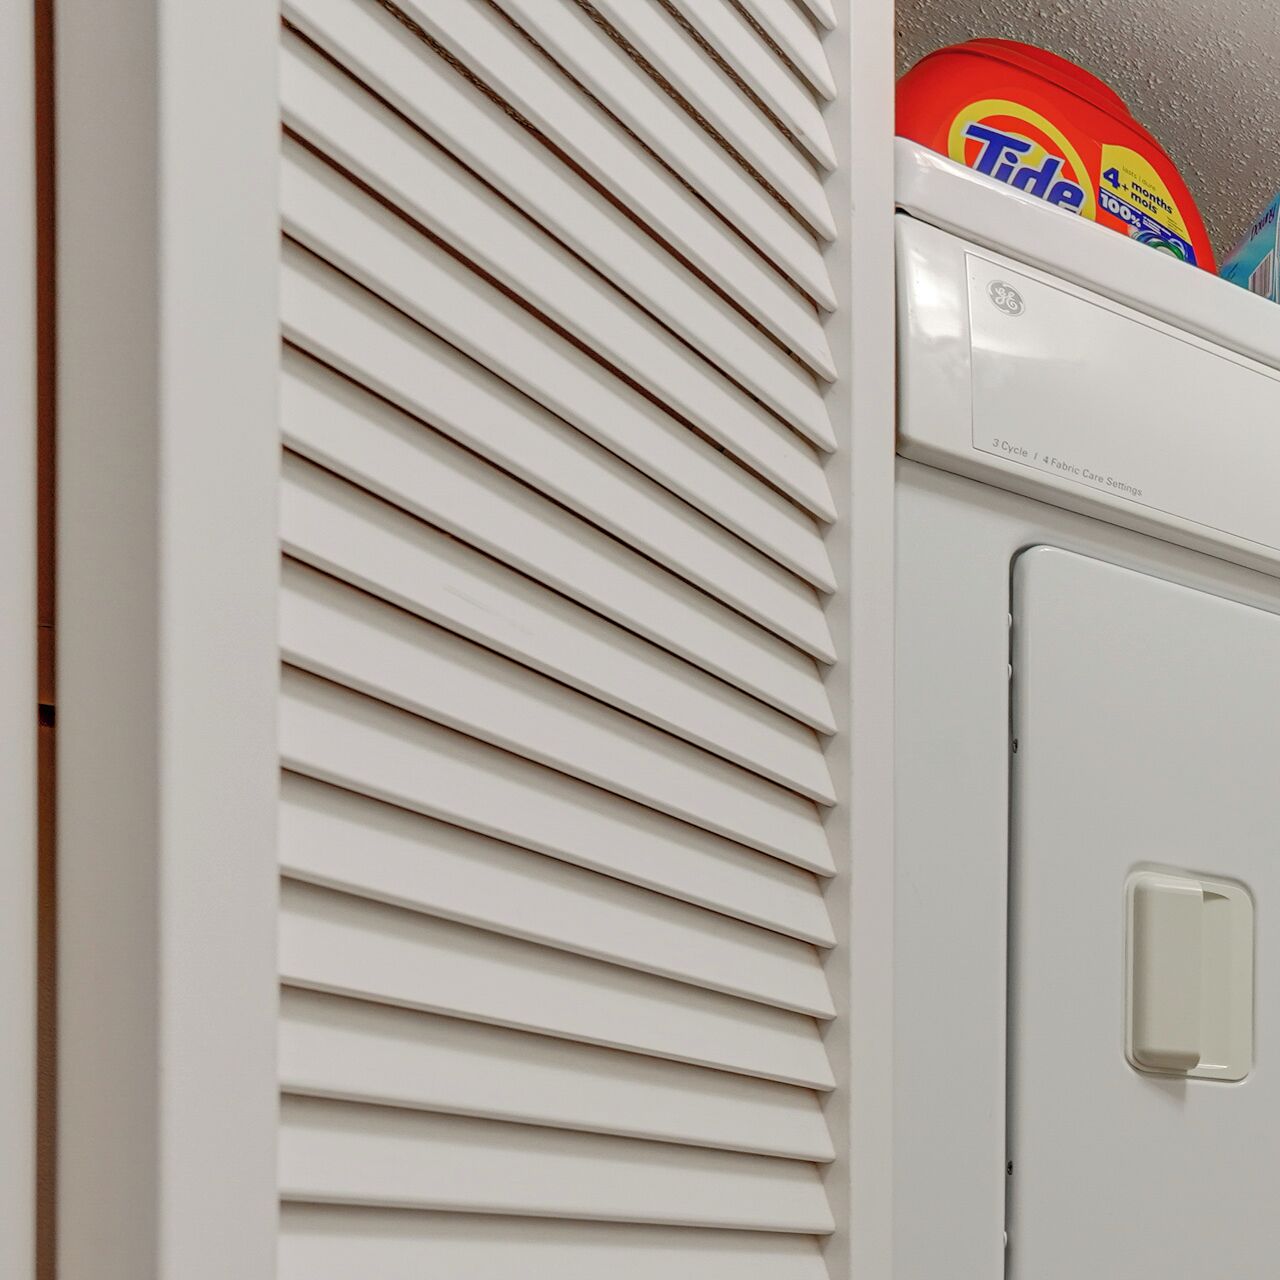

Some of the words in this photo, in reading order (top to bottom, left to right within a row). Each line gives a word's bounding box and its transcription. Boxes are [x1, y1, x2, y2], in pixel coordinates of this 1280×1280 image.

[965, 123, 1084, 215] Tide
[1100, 193, 1141, 228] 100%
[1131, 192, 1158, 214] mois
[1132, 182, 1173, 214] months
[992, 438, 1000, 448] 3
[1001, 440, 1029, 458] Cycle
[1042, 456, 1049, 464] 4
[1050, 458, 1080, 475] Fabric
[1082, 468, 1104, 483] Care
[1105, 476, 1143, 497] Settings
